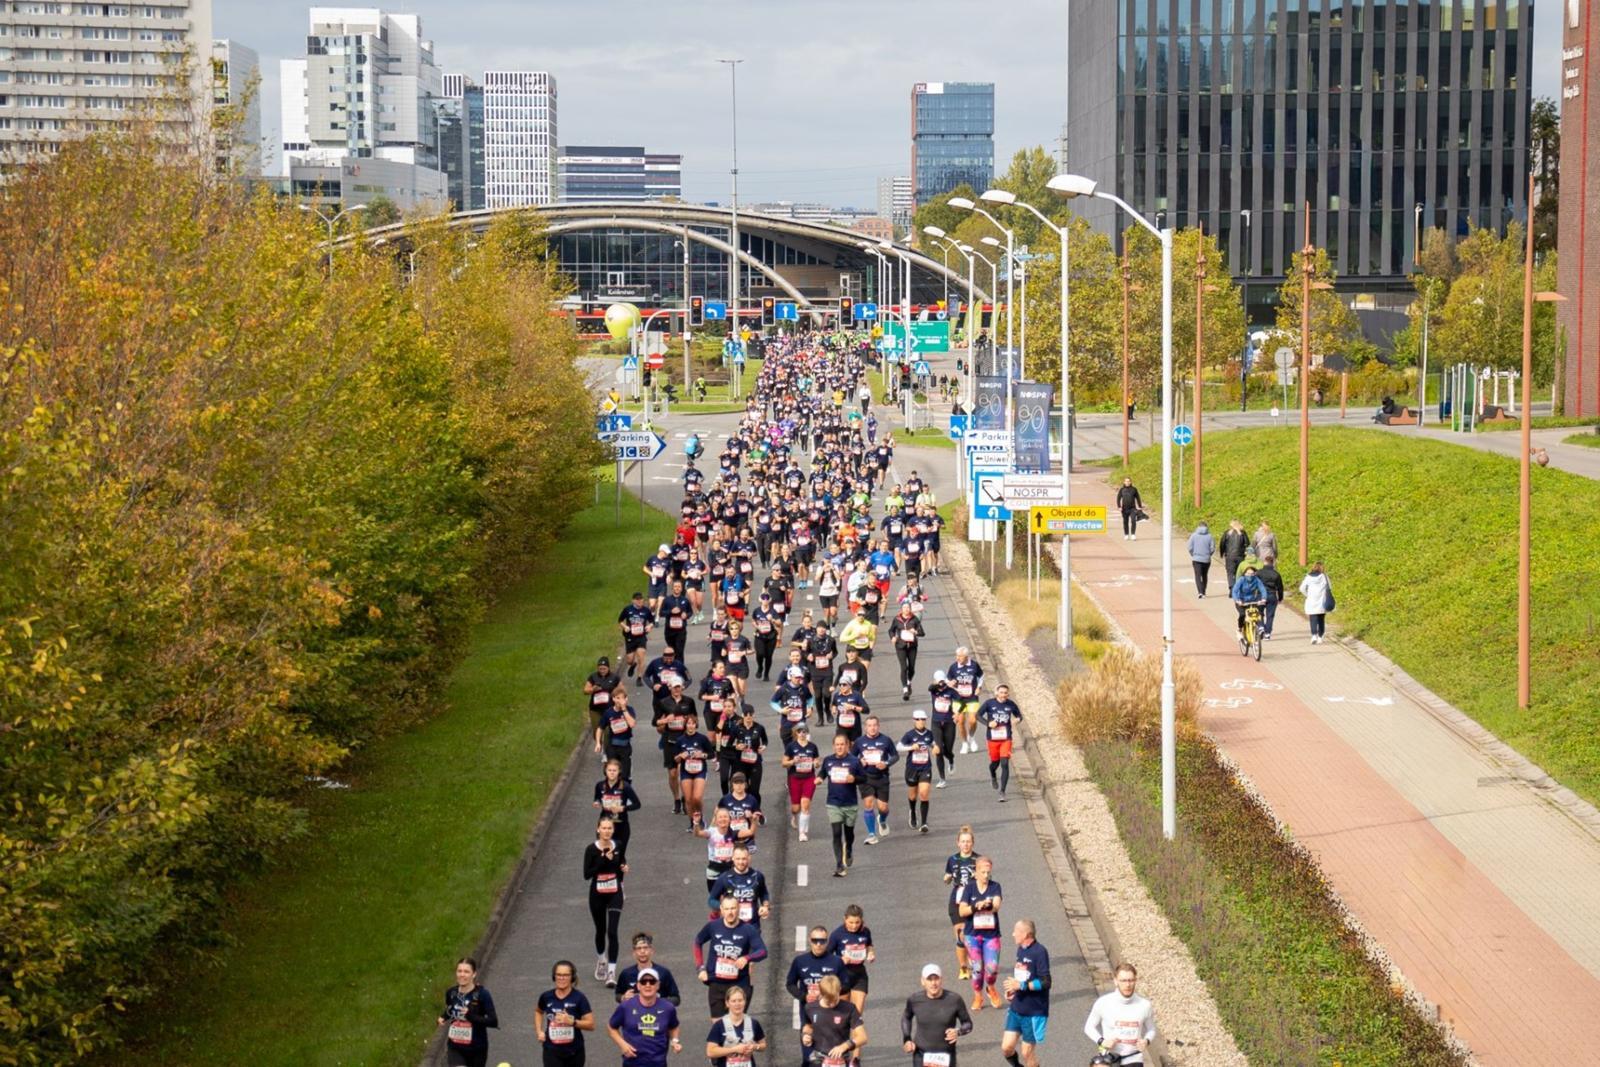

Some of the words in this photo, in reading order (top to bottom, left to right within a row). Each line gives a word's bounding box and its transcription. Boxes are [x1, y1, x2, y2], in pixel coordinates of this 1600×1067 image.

[627, 448, 635, 456] C
[1013, 488, 1049, 497] NOSPR
[1050, 508, 1082, 518] Objazd
[1085, 509, 1096, 517] do
[1066, 521, 1102, 529] Wrocław
